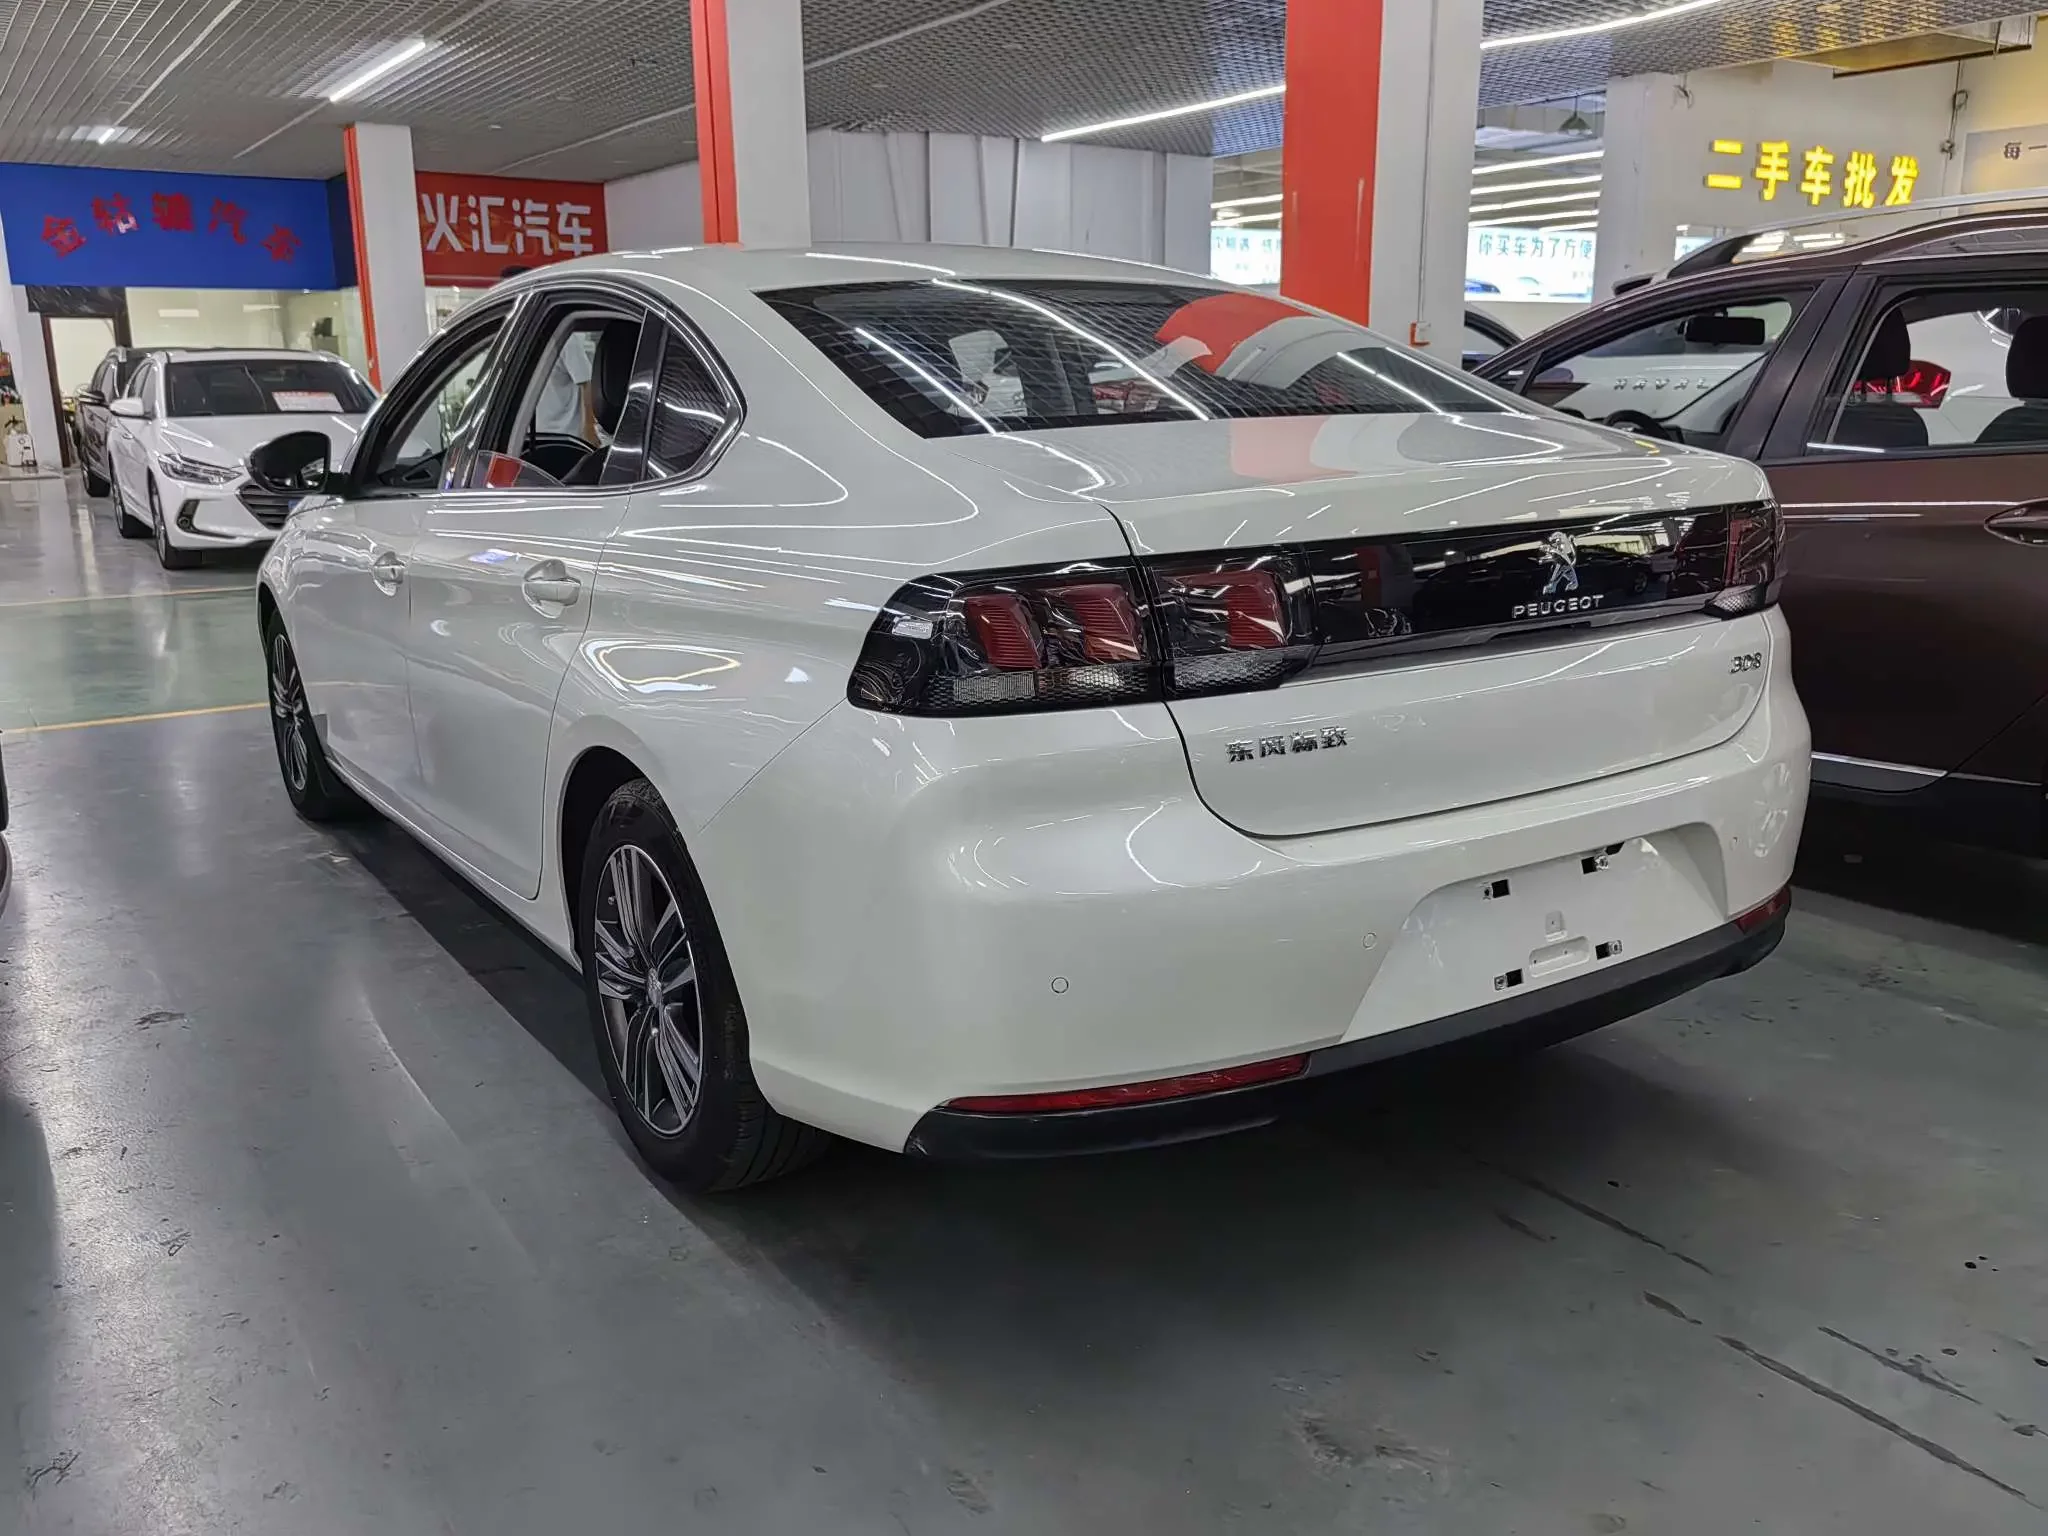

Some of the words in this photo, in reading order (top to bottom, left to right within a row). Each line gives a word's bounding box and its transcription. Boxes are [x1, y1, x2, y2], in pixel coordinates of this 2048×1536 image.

[1706, 139, 1918, 208] 二手车批发
[421, 192, 593, 255] 火汇汽车
[1479, 233, 1593, 259] 你买车为了方便
[1512, 594, 1604, 619] PEUGEOT
[1729, 652, 1762, 673] 308
[1226, 726, 1348, 762] 东风标致
